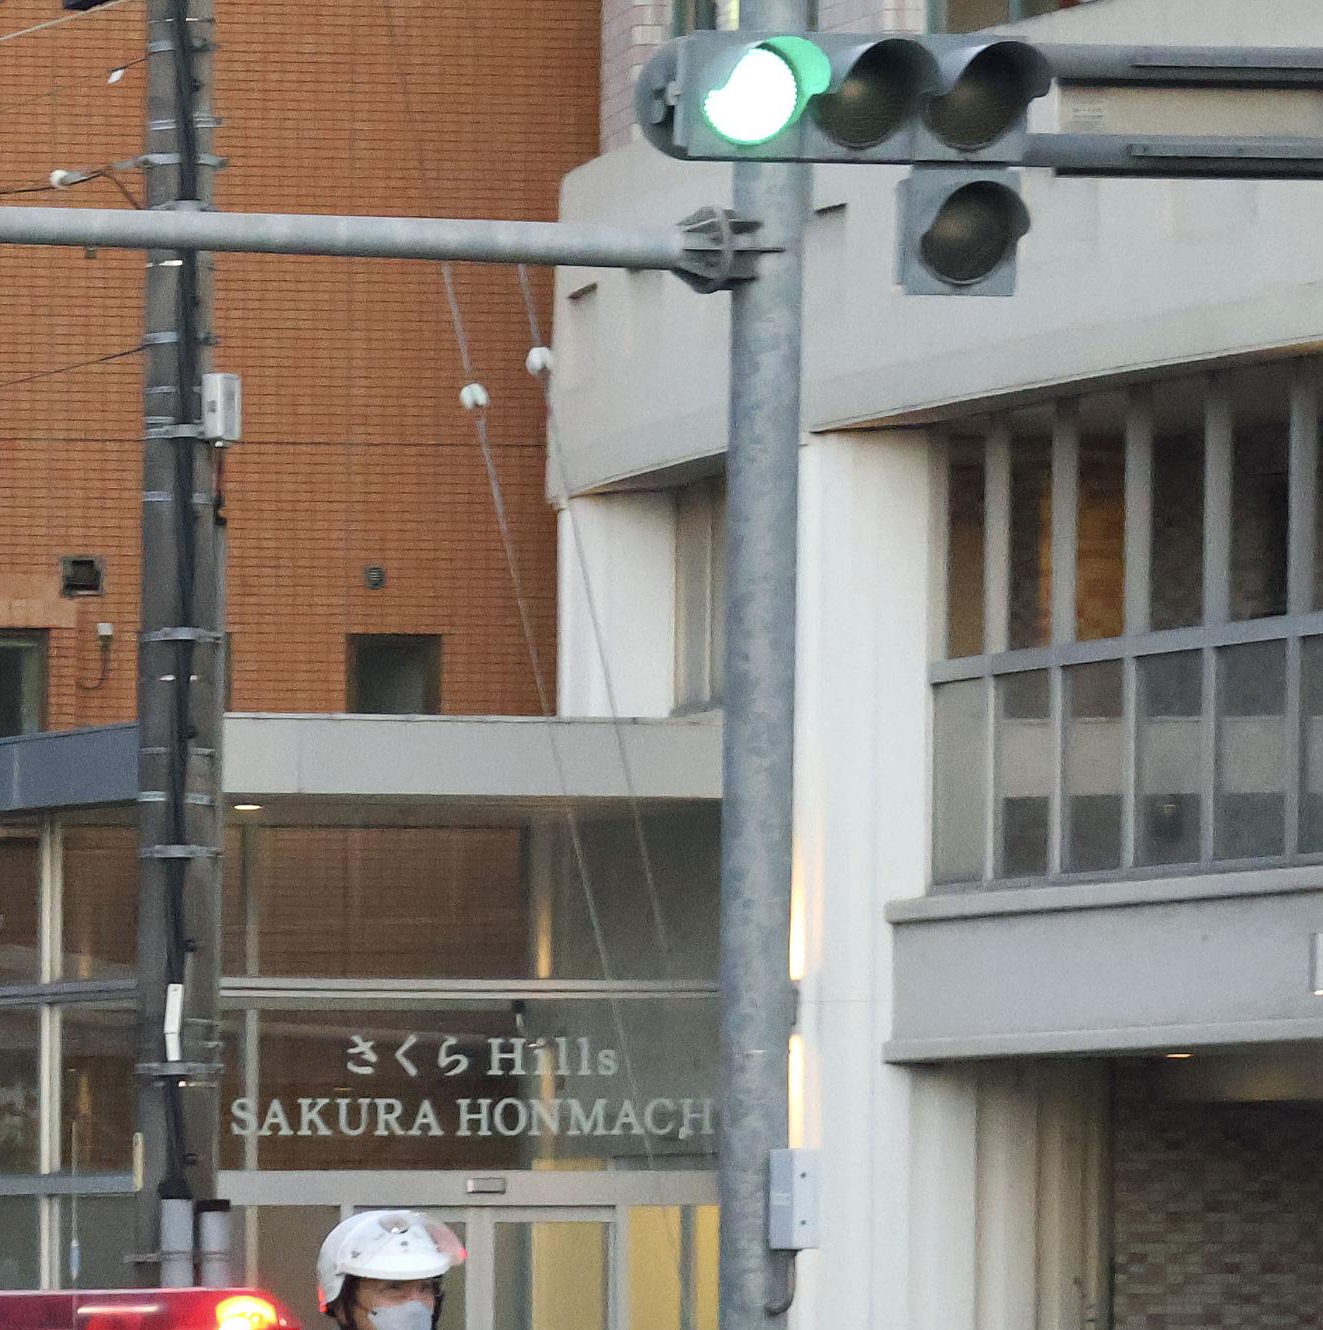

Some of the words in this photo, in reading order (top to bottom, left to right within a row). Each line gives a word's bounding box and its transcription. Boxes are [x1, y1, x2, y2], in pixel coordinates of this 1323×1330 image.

[346, 1035, 470, 1078] さくら
[487, 1036, 620, 1077] Hills
[231, 1097, 444, 1137] SAKURA
